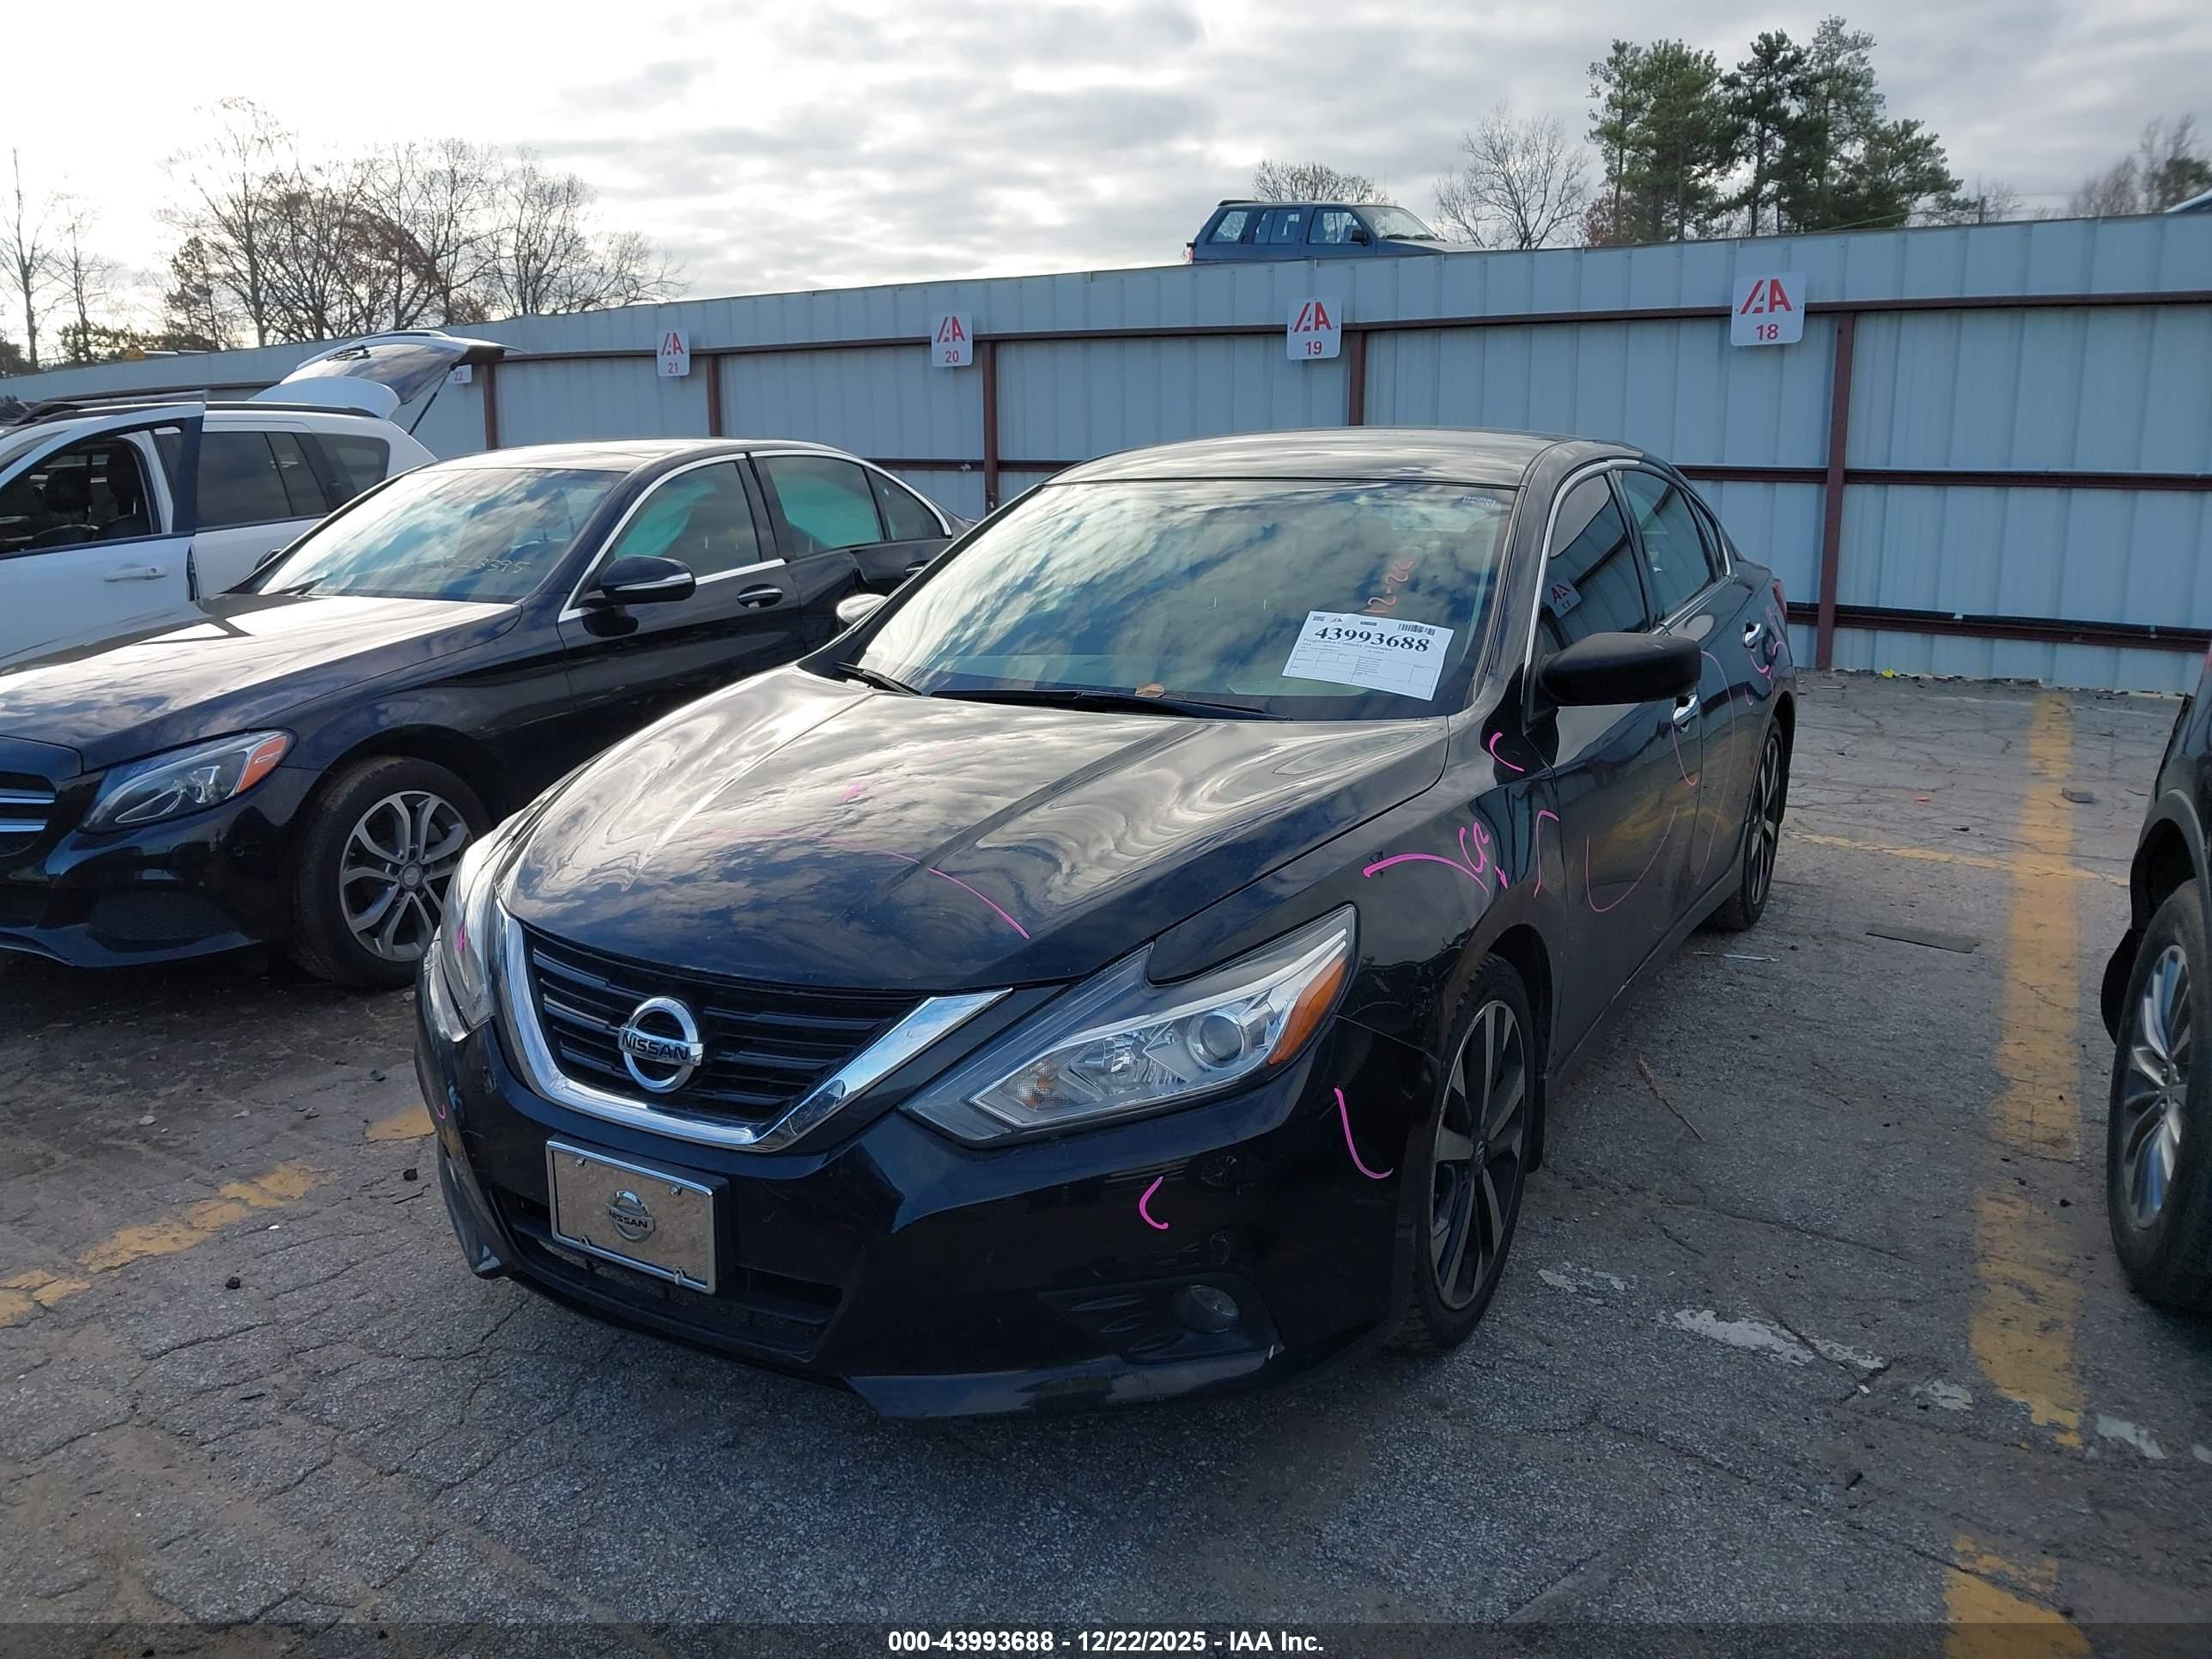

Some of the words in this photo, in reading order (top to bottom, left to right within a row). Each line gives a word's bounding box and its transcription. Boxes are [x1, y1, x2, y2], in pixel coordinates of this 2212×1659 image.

[1755, 324, 1779, 342] 18
[1304, 340, 1322, 356] 19
[945, 350, 959, 364] 20
[453, 371, 464, 381] 22
[667, 362, 679, 374] 21
[1315, 627, 1431, 653] 43993688
[621, 1032, 690, 1060] NISSAN
[608, 1210, 648, 1229] NISSAN
